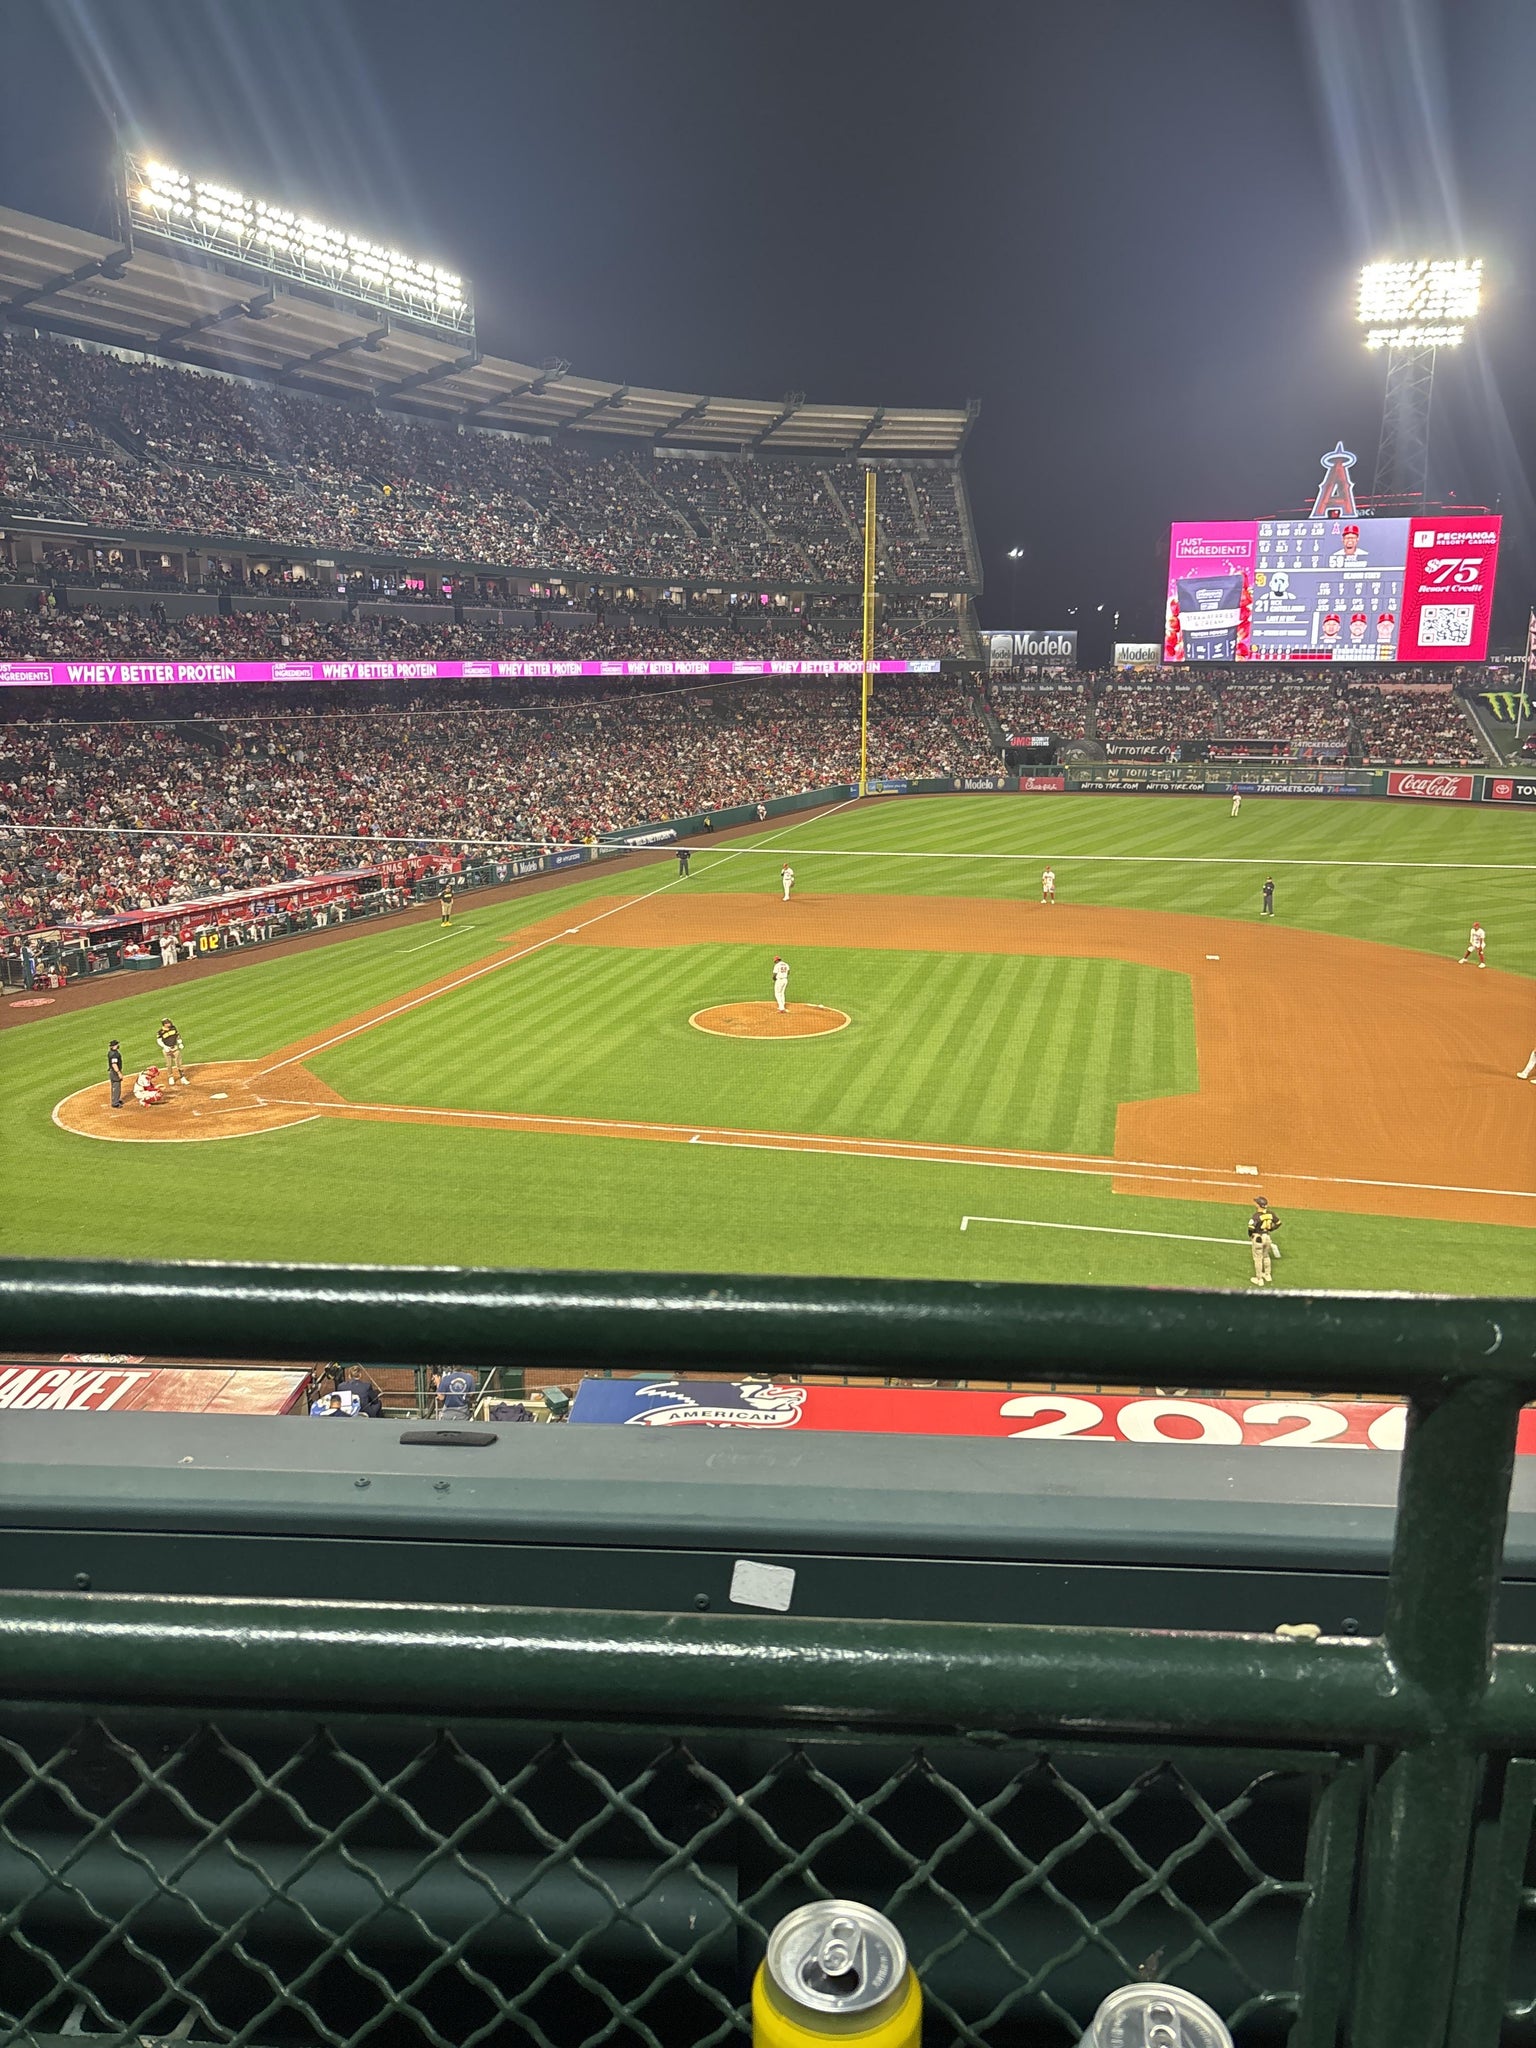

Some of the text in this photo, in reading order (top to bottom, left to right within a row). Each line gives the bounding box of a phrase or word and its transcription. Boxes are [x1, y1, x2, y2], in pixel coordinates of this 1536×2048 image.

[1437, 532, 1496, 540] PECHANGA
[1180, 538, 1203, 547] JUST
[1181, 546, 1247, 555] INGREDIENTS
[1424, 558, 1484, 584] $75
[1418, 584, 1483, 593] Resort Credit
[1254, 600, 1269, 612] 21
[1014, 635, 1072, 656] Modelo
[1121, 648, 1156, 660] Modelo
[322, 664, 437, 678] WHEY BETTER PROTEIN
[498, 663, 582, 675] WHEY BETTER PROTEIN
[628, 662, 649, 673] WHEY
[650, 662, 673, 673] BETTER
[675, 662, 709, 673] PROTEIN
[770, 662, 798, 672] WHEY
[801, 662, 835, 672] BETTER
[838, 662, 880, 672] PROTEIN
[67, 665, 236, 682] WHEY BETTER PROTEIN
[965, 779, 993, 790] Modelo
[1171, 783, 1204, 791] TIRE.COM
[1257, 785, 1323, 793] 714TICKETS.COM
[563, 854, 581, 862] HYUNDAI
[519, 861, 538, 874] Modelo
[669, 1409, 777, 1421] AMERICAN
